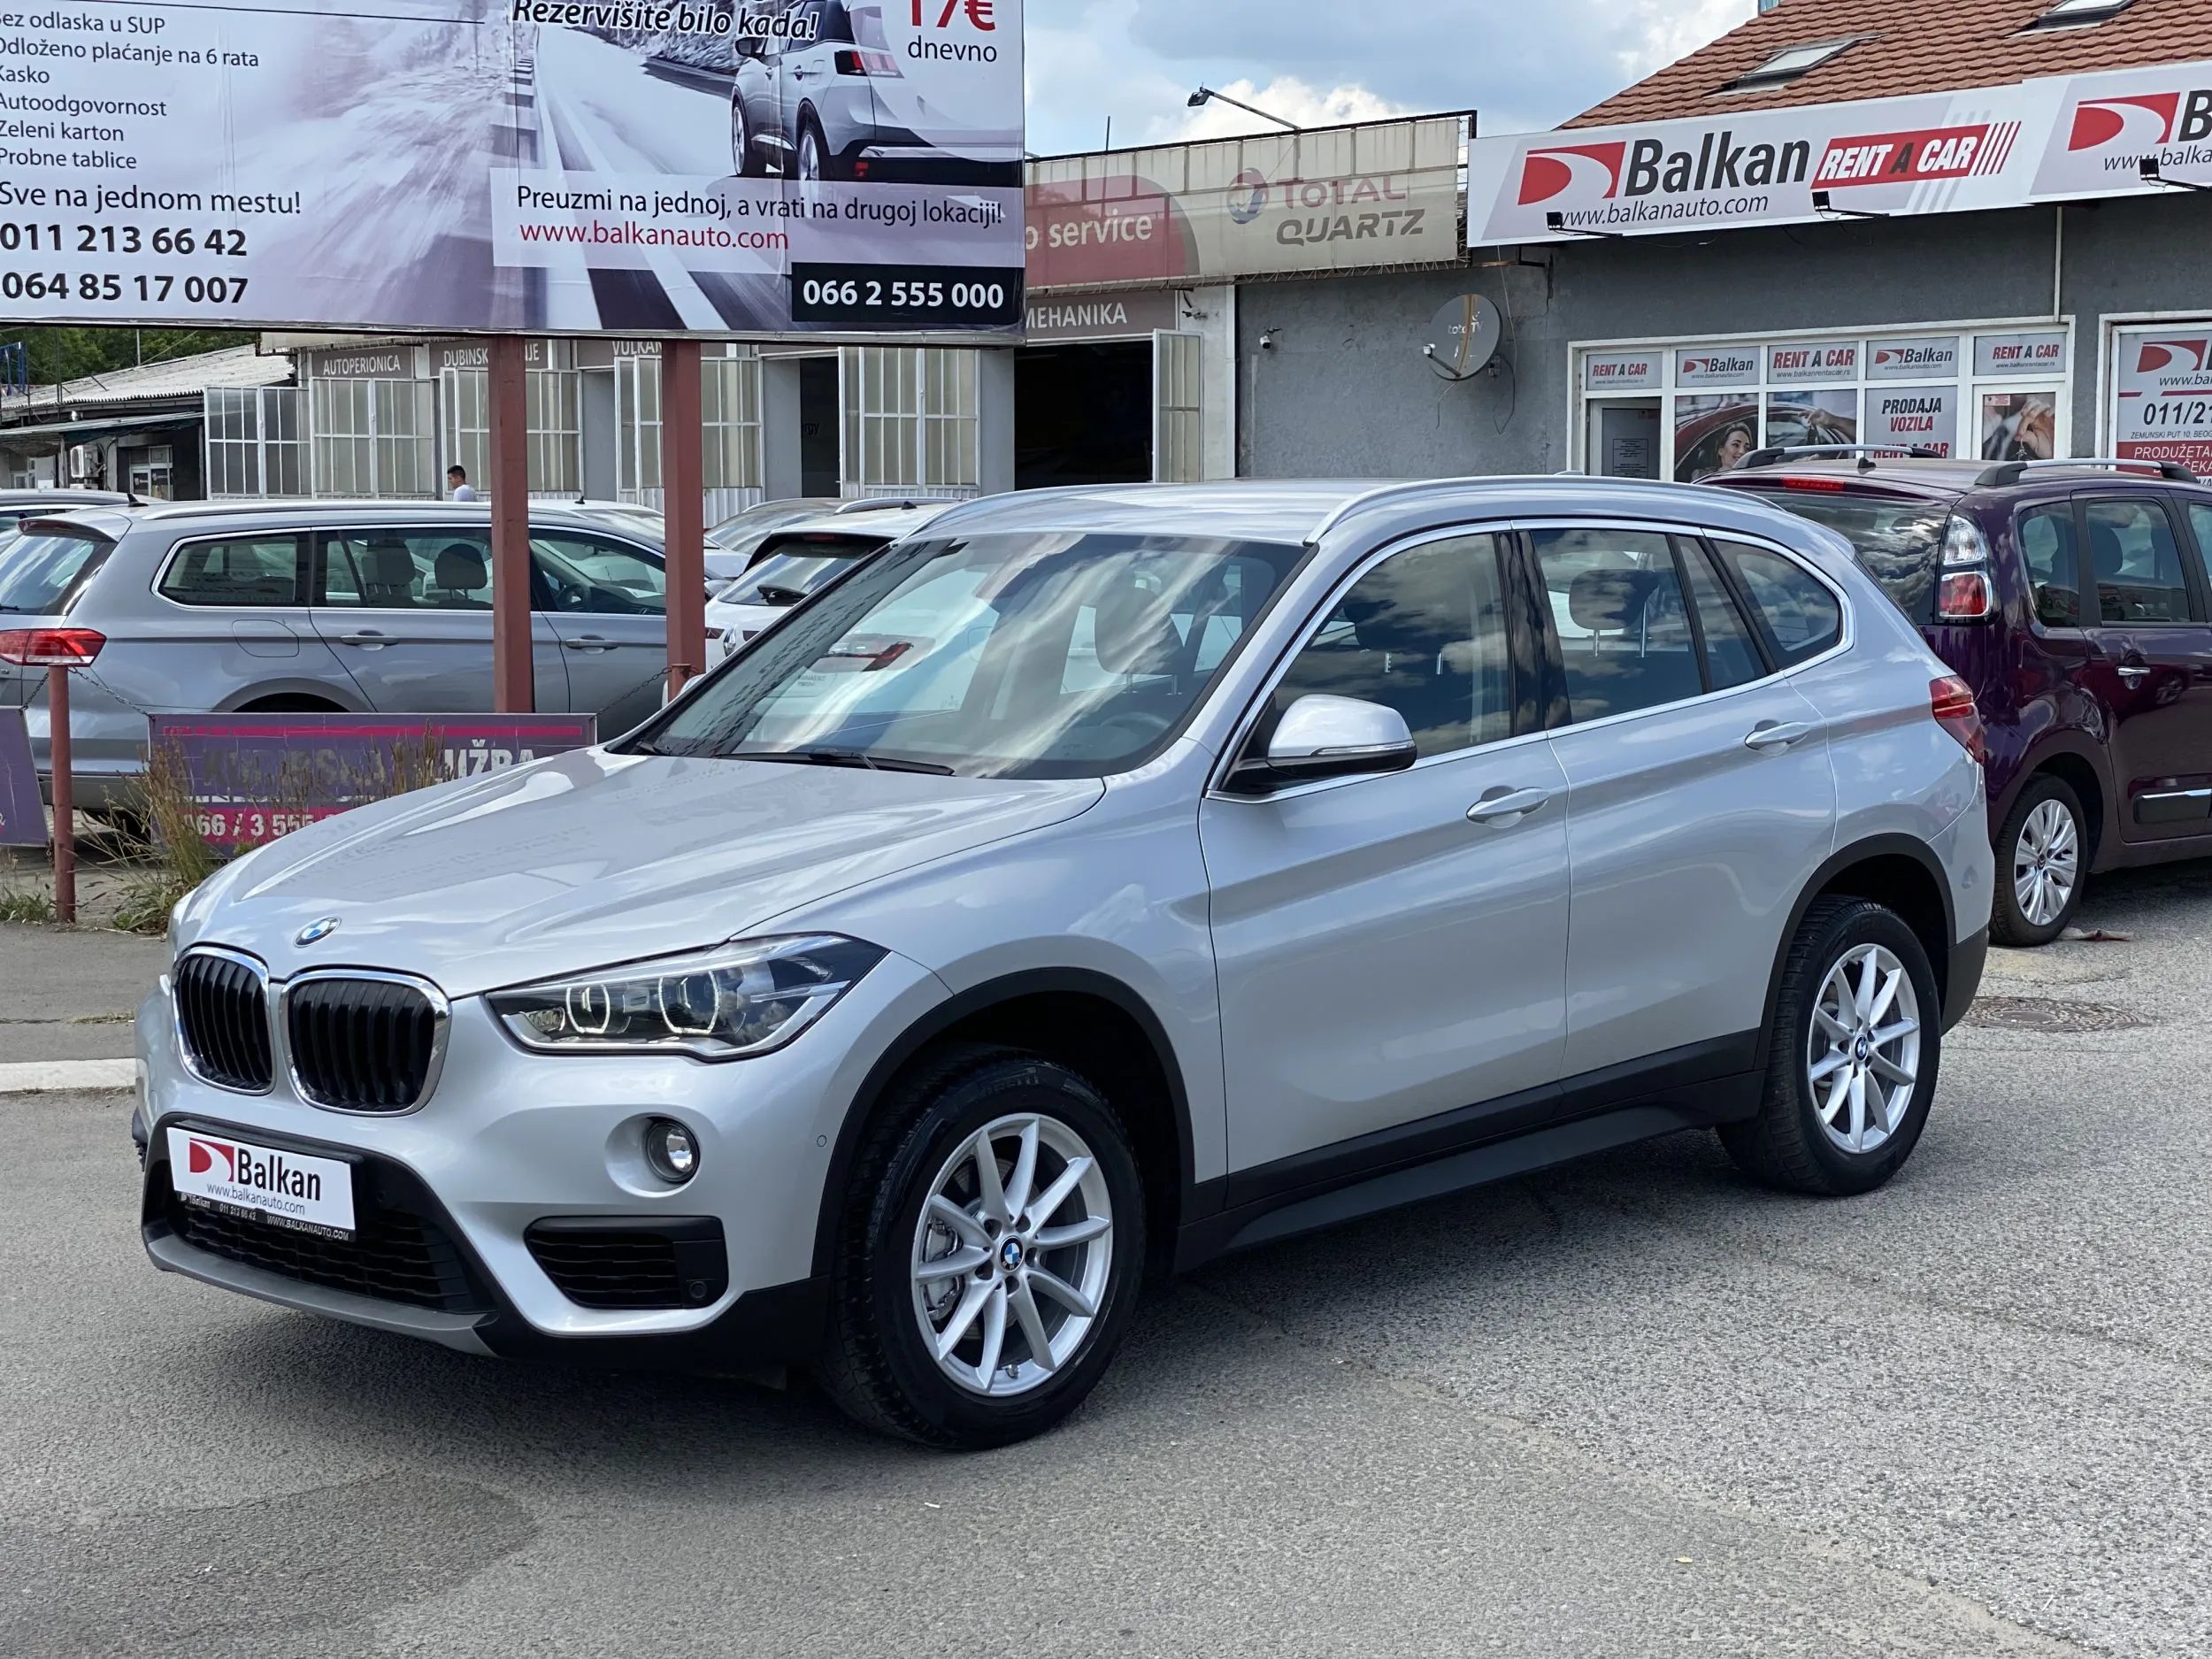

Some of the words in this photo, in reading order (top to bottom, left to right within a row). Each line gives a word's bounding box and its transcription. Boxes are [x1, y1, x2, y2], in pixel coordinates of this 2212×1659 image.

[0, 11, 25, 27] ez
[29, 11, 104, 31] odlaska
[111, 19, 122, 32] u
[127, 16, 165, 35] SUP
[512, 0, 671, 31] Rezervišite
[678, 3, 732, 35] bilo
[738, 7, 818, 40] kada!
[92, 42, 173, 66] plaćanje
[178, 48, 201, 65] na
[205, 48, 218, 65] 6
[222, 50, 259, 67] rata
[907, 35, 997, 63] dnevno
[0, 119, 55, 139] Zeleni
[61, 122, 125, 142] karton
[0, 147, 67, 167] Probne
[72, 150, 137, 170] tablice
[1624, 130, 1810, 198] Balkan
[1816, 143, 1894, 181] RENT
[1887, 142, 1915, 175] A
[1916, 135, 1978, 173] CAR
[0, 180, 46, 206] Sve
[55, 187, 88, 207] na
[94, 184, 202, 214] jednom
[211, 190, 301, 215] mestu!
[517, 185, 612, 211] Preuzmi
[619, 194, 647, 212] na
[651, 190, 732, 221] jednoj,
[737, 198, 749, 216] a
[756, 196, 805, 219] vrati
[812, 201, 838, 219] na
[844, 196, 917, 227] drugoj
[923, 199, 1002, 229] lokaciji!
[1276, 176, 1407, 211] TOTAL
[0, 222, 62, 251] 011
[77, 224, 142, 254] 213
[151, 227, 196, 255] 66
[204, 228, 248, 257] 42
[519, 219, 788, 250] www.balkanauto.com
[1048, 208, 1153, 249] service
[1276, 208, 1425, 248] QUARTZ
[2, 272, 70, 300] 064
[79, 273, 122, 301] 85
[134, 274, 174, 302] 17
[184, 275, 249, 303] 007
[803, 279, 858, 306] 066
[865, 280, 882, 306] 2
[890, 280, 943, 307] 555
[951, 282, 1004, 309] 000
[323, 354, 401, 376] AUTOPERIONICA
[1709, 357, 1754, 373] Balkan
[1772, 350, 1810, 369] RENT
[1811, 349, 1822, 367] A
[1825, 349, 1855, 366] CAR
[1903, 347, 1953, 364] Balkan
[1993, 345, 2024, 360] RENT
[2024, 344, 2032, 358] A
[2035, 343, 2060, 358] CAR
[1592, 364, 1617, 377] RENT
[1617, 363, 1625, 376] A
[1627, 363, 1647, 376] CAR
[1881, 396, 1942, 415] PRODAJA
[1890, 415, 1933, 432] VOZILA
[2130, 431, 2165, 440] ZEMUNSKI
[2166, 430, 2182, 439] PUT
[2133, 443, 2212, 459] PRODUŽETA
[250, 813, 265, 837] 3
[237, 1147, 321, 1202] Balkan
[206, 1182, 305, 1217] www.balkanauto.com
[219, 1202, 229, 1215] 011
[230, 1205, 240, 1217] 213
[249, 1210, 257, 1221] 42
[266, 1214, 349, 1242] WWW.BALKANAUTO.COM
